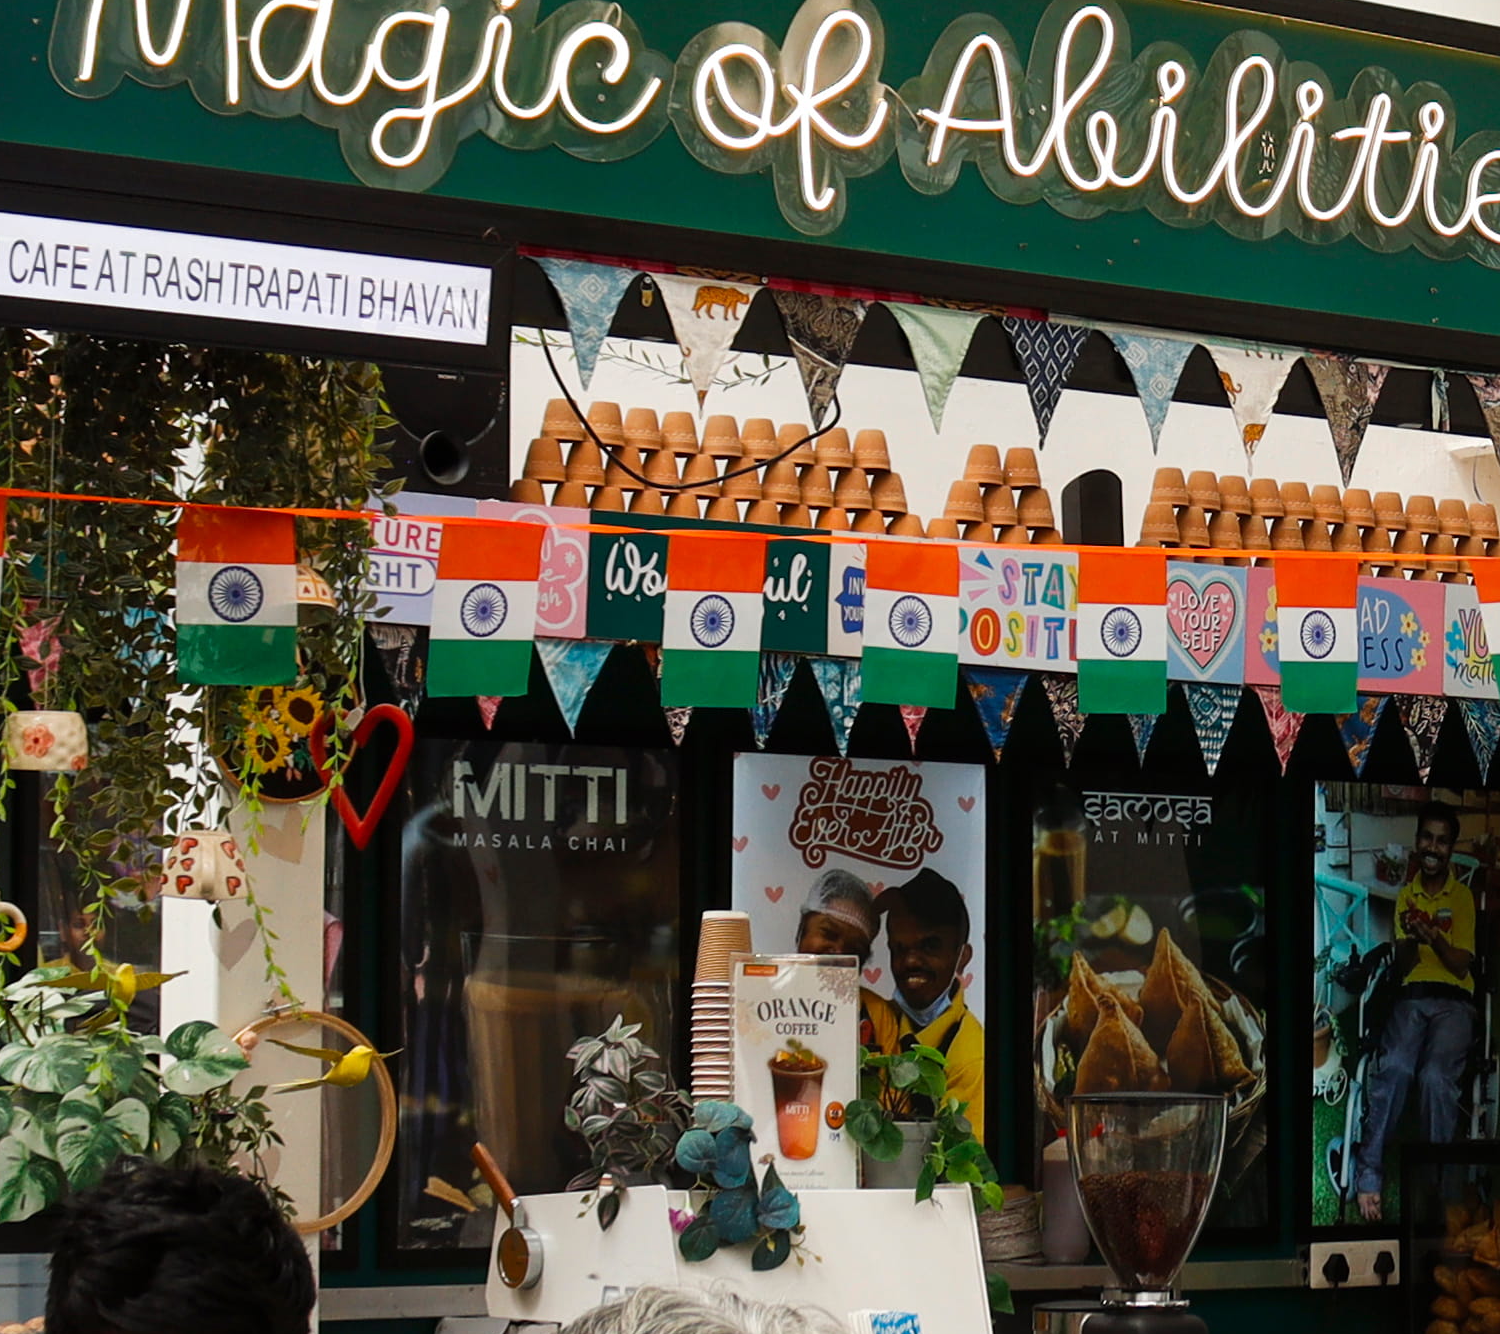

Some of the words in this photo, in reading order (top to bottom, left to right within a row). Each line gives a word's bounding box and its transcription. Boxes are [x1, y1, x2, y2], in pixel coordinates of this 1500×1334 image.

[697, 9, 889, 211] of
[9, 239, 89, 291] CAFE
[99, 249, 137, 297] AT
[143, 252, 349, 318] RASHTRAPATI
[359, 278, 479, 332] BHAVAN
[368, 517, 442, 553] TURE
[367, 560, 422, 590] GHT
[1179, 590, 1220, 614] LOVE
[1361, 597, 1389, 633] AD
[1179, 611, 1221, 633] YOUR
[1180, 632, 1221, 653] SELF
[1363, 637, 1404, 671] ESS
[452, 760, 629, 825] MITTI
[803, 760, 920, 817] Happily
[452, 832, 554, 851] MASALA
[568, 835, 629, 853] CHAI
[792, 804, 863, 850] Ever
[861, 802, 941, 860] After
[1094, 828, 1121, 845] AT
[1135, 829, 1202, 847] MITTI
[756, 997, 838, 1025] ORANGE
[775, 1021, 820, 1037] COFFEE
